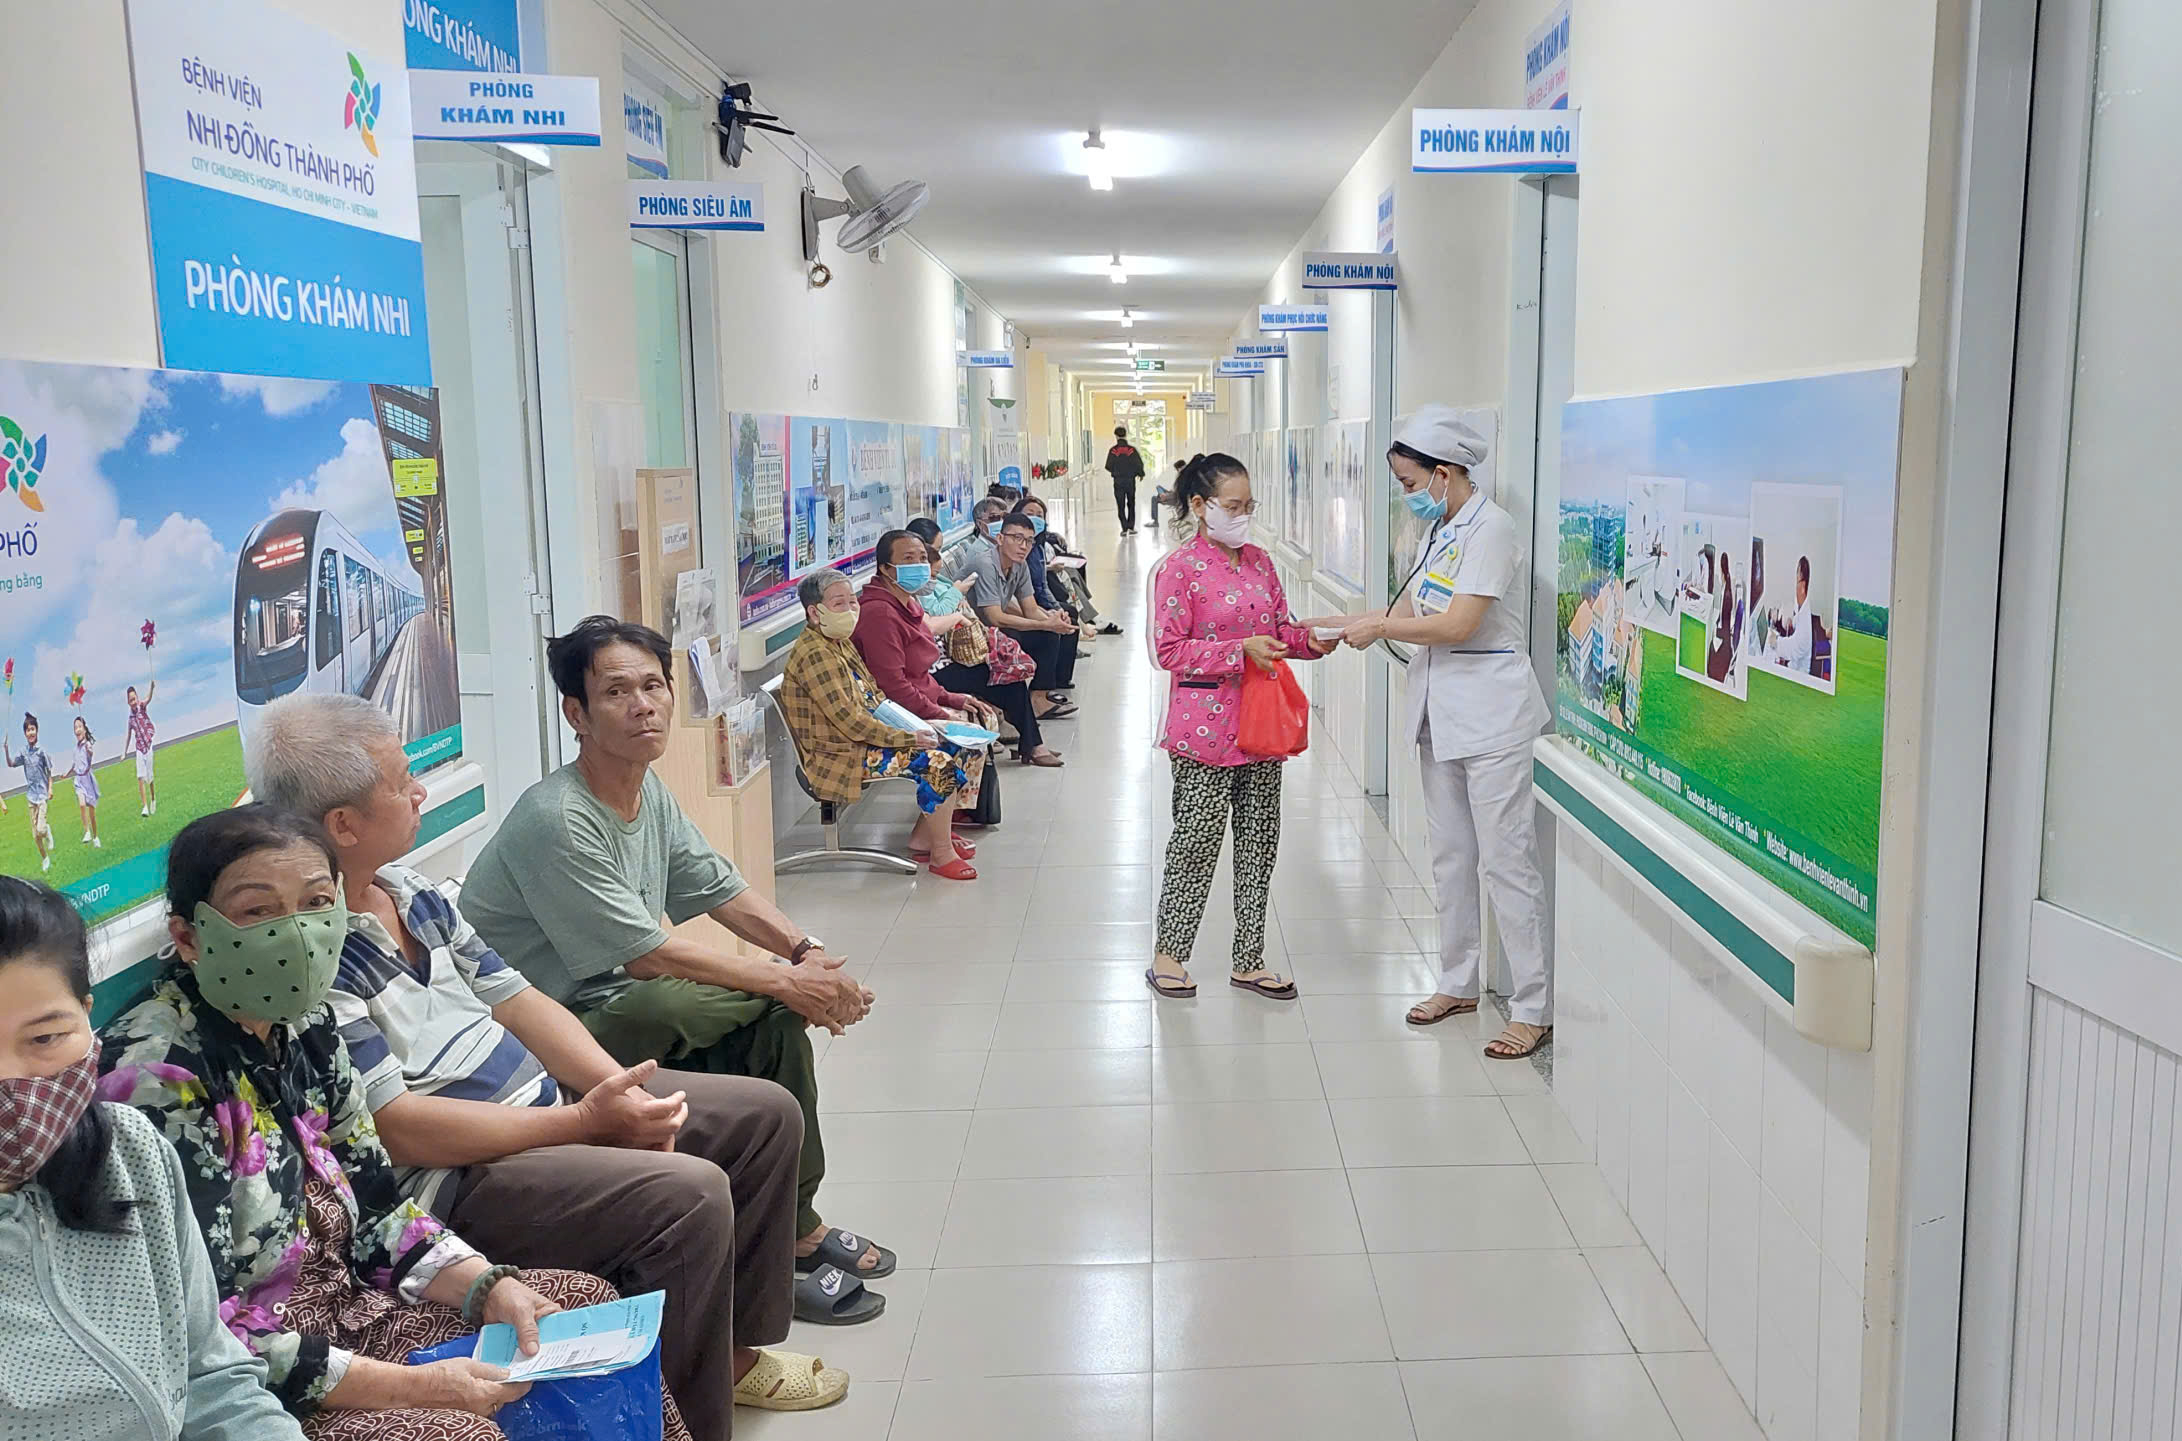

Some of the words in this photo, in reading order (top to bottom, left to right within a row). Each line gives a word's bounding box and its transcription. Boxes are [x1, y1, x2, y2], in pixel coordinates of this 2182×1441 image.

[444, 21, 491, 72] KHÁM
[182, 56, 226, 95] BỆNH
[228, 75, 263, 111] VIỆN
[469, 79, 534, 99] PHÒNG
[441, 105, 514, 125] KHÁM
[523, 110, 566, 126] NHI
[187, 110, 222, 150] NHI
[224, 121, 281, 168] ĐỒNG
[284, 143, 340, 186] THÀNH
[343, 162, 375, 196] PHỐ
[1420, 124, 1479, 153] PHÒNG
[1484, 125, 1535, 153] KHÁM
[1541, 125, 1570, 158] NỘI
[192, 156, 210, 172] CITY
[639, 192, 689, 217] PHÒNG
[692, 194, 725, 217] SIÊU
[729, 195, 752, 218] ÂM
[1306, 260, 1341, 278] PHÒNG
[1344, 262, 1374, 279] KHÁM
[1376, 264, 1394, 283] NỘI
[184, 253, 293, 322] PHÒNG
[296, 273, 370, 332] KHÁM
[372, 293, 411, 337] NHI
[1236, 345, 1255, 354] PHÒNG
[1256, 345, 1272, 354] KHÁM
[16, 571, 43, 590] bằng
[1766, 829, 1789, 862] Website:
